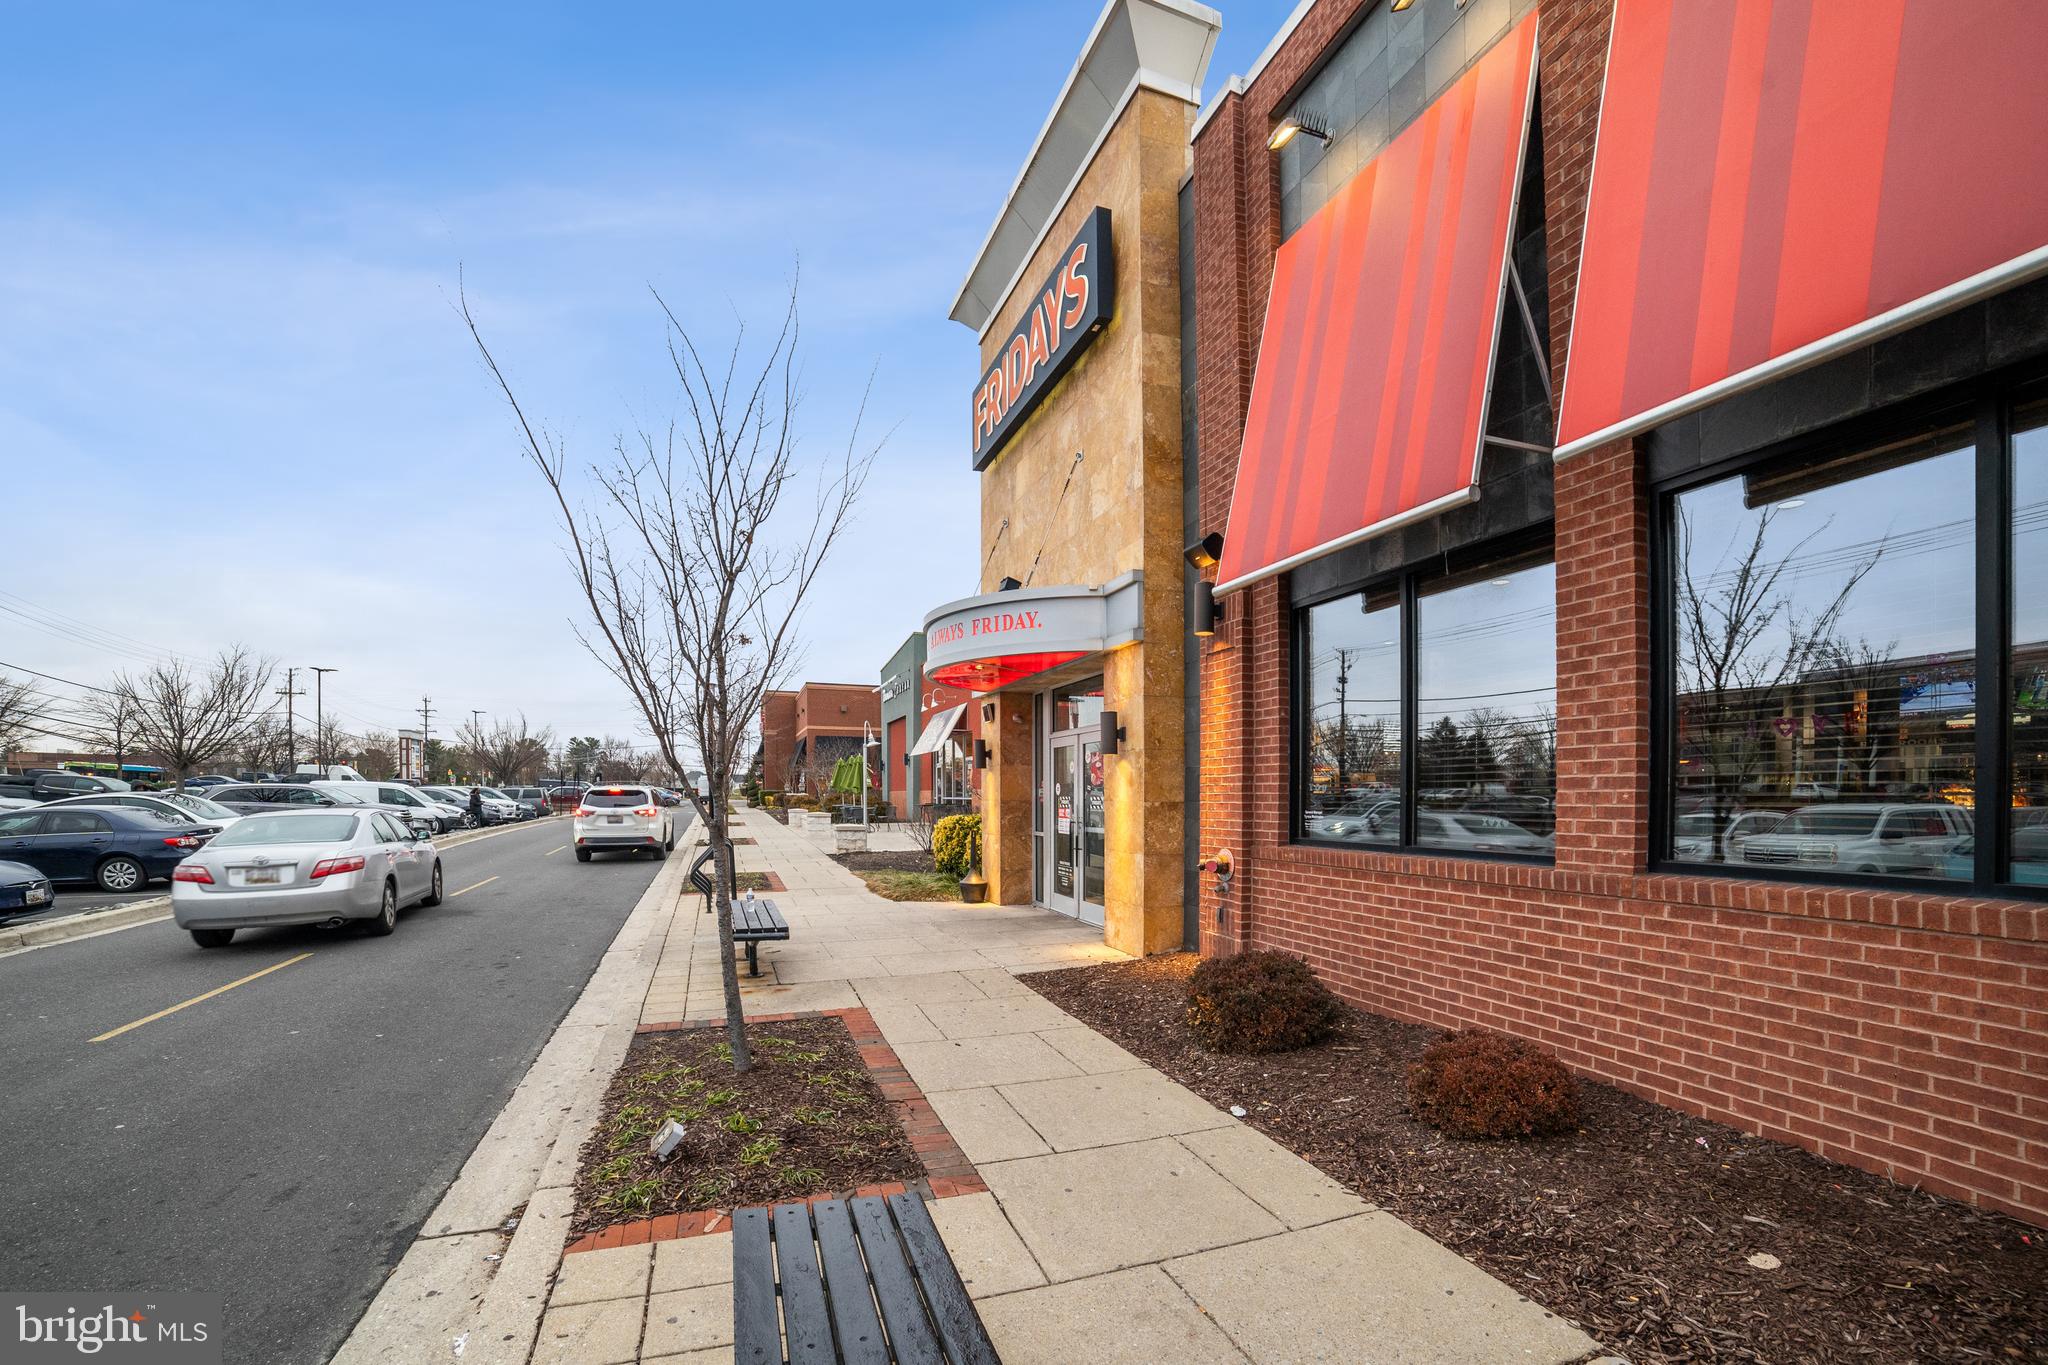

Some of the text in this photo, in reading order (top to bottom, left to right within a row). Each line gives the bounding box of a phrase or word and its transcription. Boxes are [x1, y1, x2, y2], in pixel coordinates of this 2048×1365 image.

[973, 243, 1089, 453] FRIDAYS
[930, 610, 1042, 649] ALWAYS FRIDAY.
